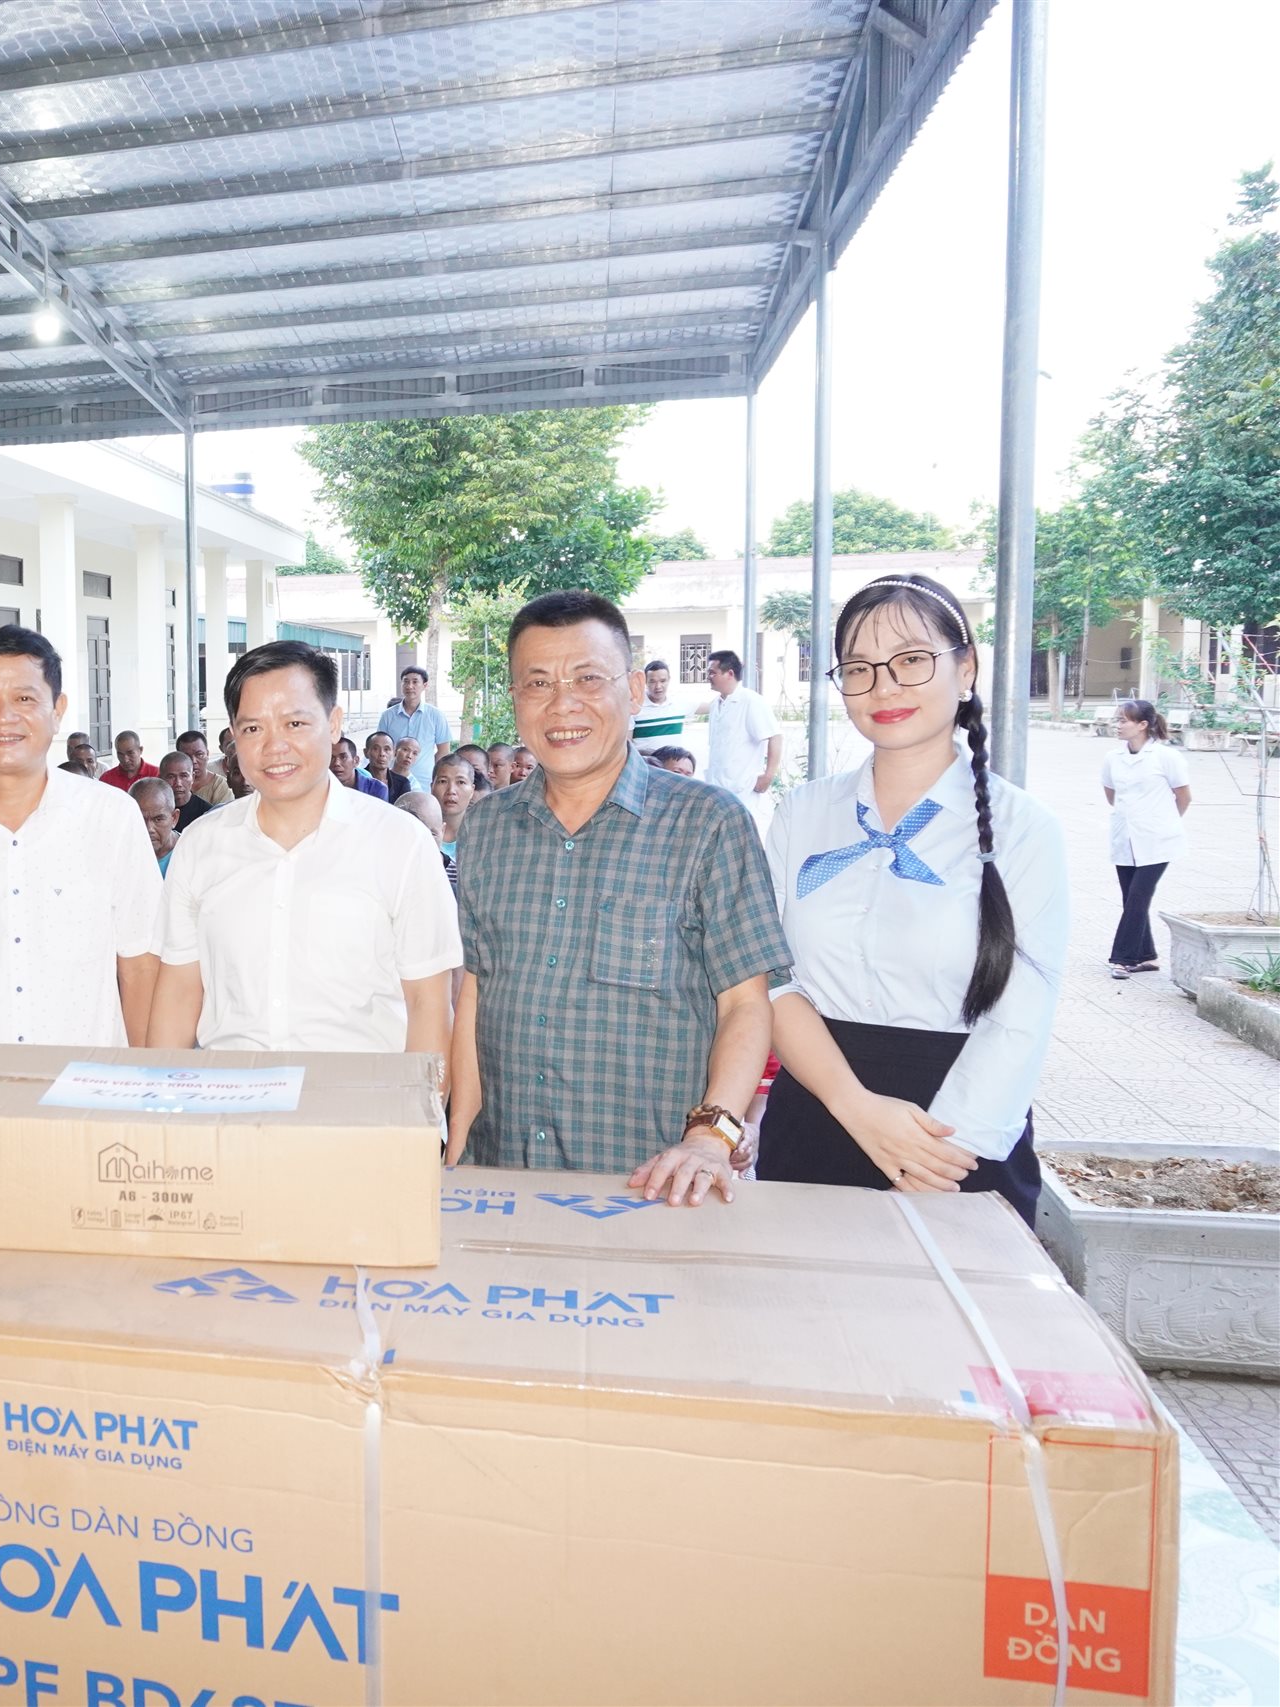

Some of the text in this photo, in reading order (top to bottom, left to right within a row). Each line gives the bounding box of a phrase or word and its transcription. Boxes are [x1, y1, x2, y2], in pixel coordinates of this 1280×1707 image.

[152, 1191, 194, 1204] 300W
[169, 1210, 193, 1220] IP67
[319, 1298, 646, 1329] ĐIN MÁY GIA DỤNG
[486, 1284, 675, 1315] PHÁT
[3, 1400, 199, 1452] HÒA PHÁT
[6, 1437, 183, 1471] ĐIỆN MÁY GIA DỤNG
[71, 1506, 139, 1539] DÀN
[152, 1513, 255, 1555] ĐỒNG
[137, 1559, 401, 1666] PHÁT
[1006, 1629, 1121, 1674] ĐỒNG
